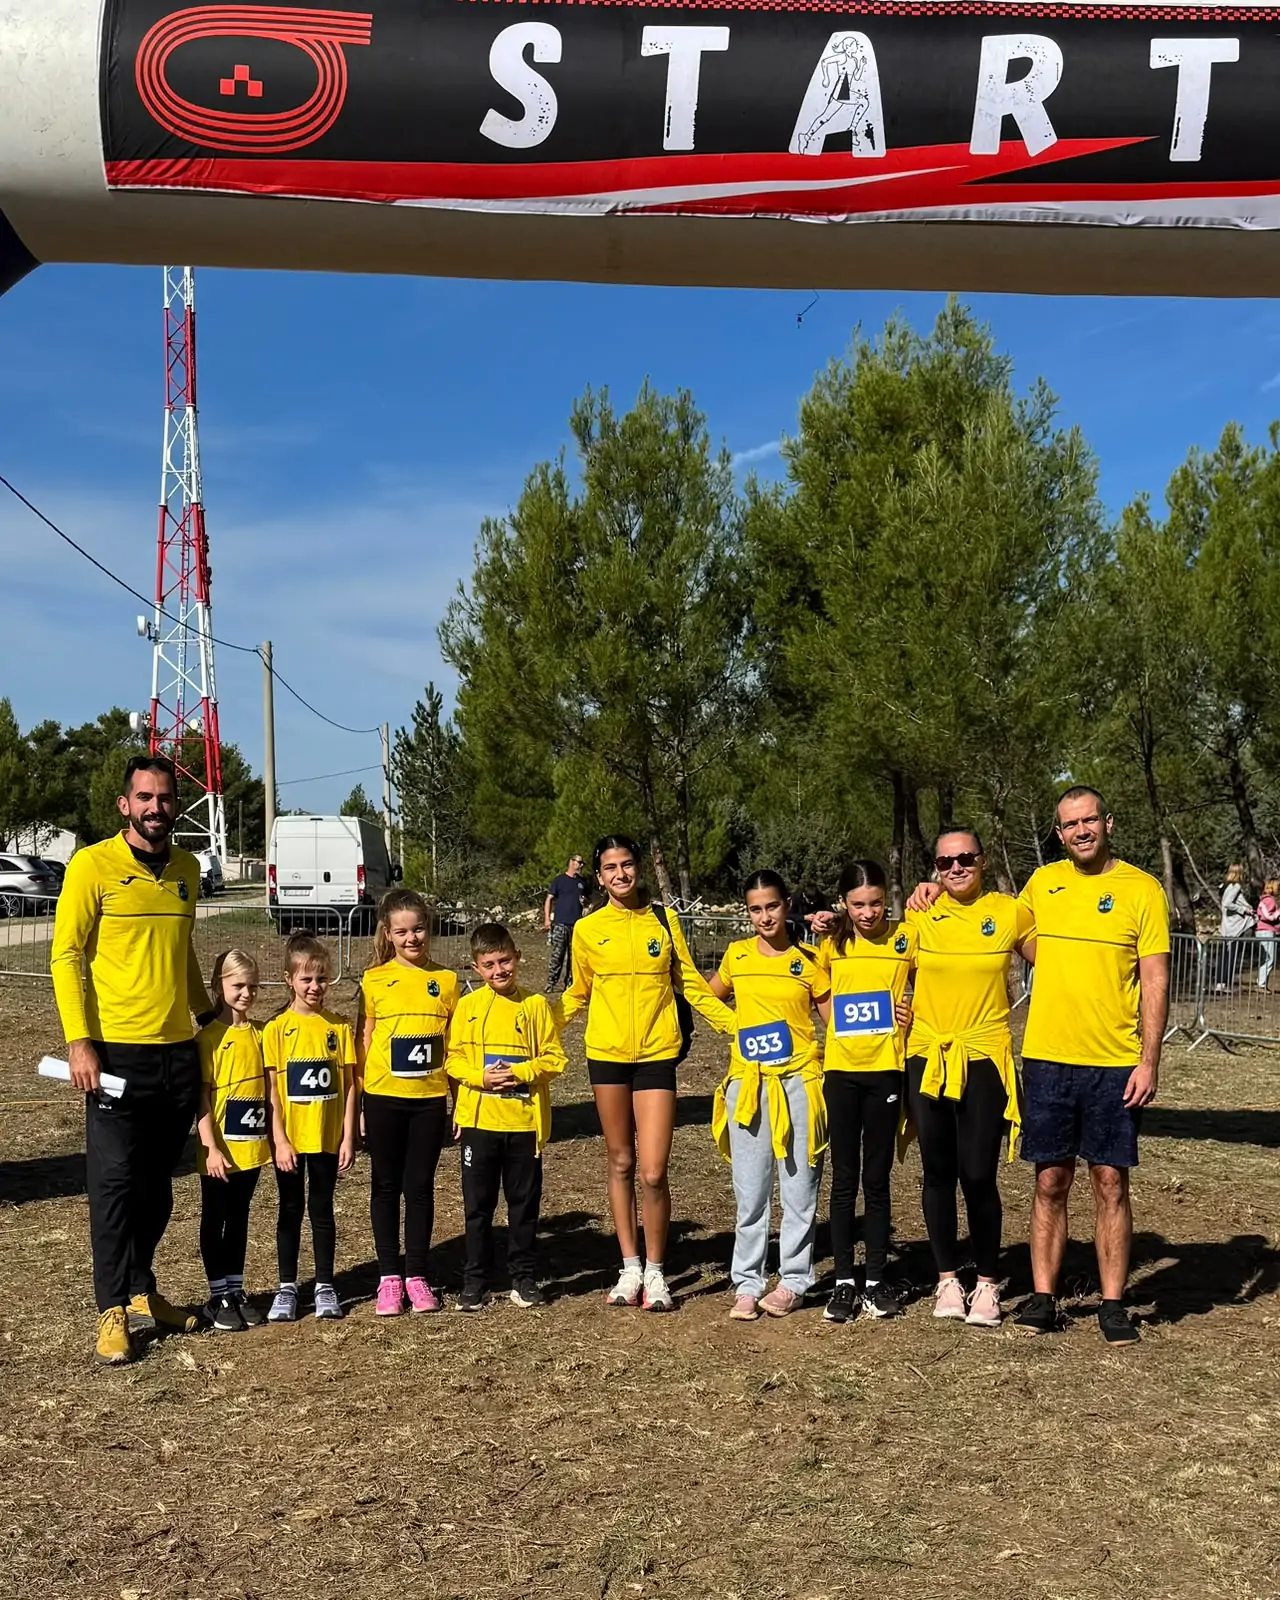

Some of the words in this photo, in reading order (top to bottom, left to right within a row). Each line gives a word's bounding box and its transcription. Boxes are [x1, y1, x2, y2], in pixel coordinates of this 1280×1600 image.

[479, 22, 1240, 162] START
[844, 1001, 880, 1024] 931
[407, 1043, 432, 1065] 41
[745, 1031, 783, 1057] 933
[300, 1067, 332, 1089] 40
[240, 1107, 266, 1128] 42
